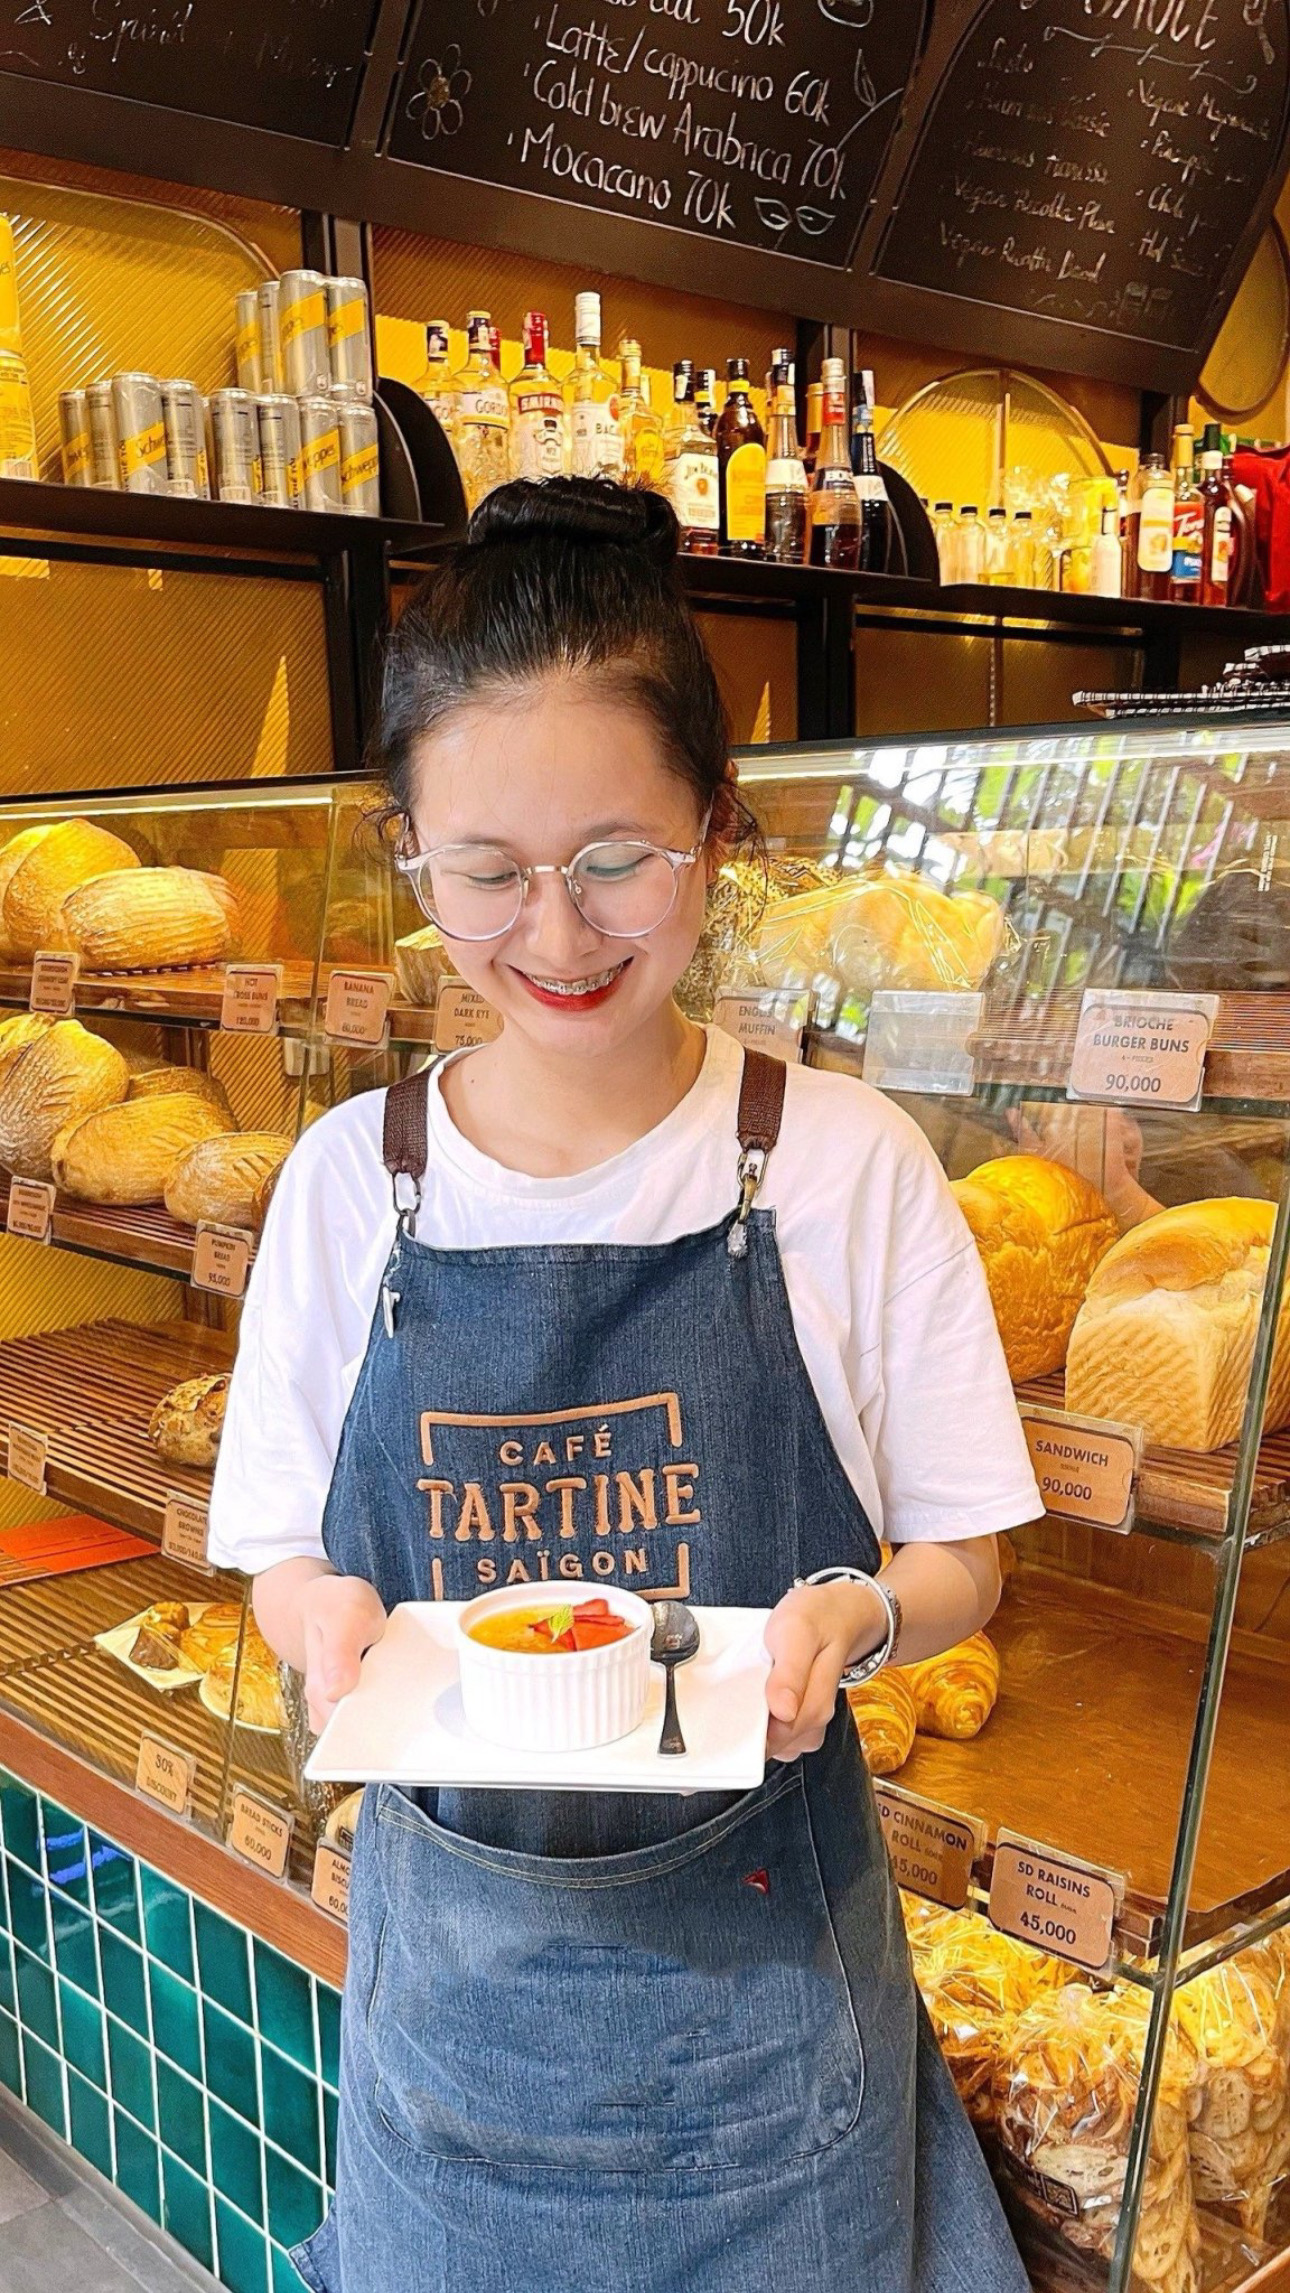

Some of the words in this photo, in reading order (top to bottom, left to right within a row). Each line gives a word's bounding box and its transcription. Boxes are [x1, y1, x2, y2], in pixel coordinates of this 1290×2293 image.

[722, 0, 785, 47] 50k
[785, 70, 830, 126] 60k
[534, 60, 595, 117] Cold
[673, 102, 792, 184] Arabrica
[684, 170, 736, 229] 70k
[344, 981, 375, 995] BANANA
[738, 1022, 776, 1036] MUFFIN
[1113, 1015, 1176, 1031] BRIOCHE
[1093, 1034, 1147, 1050] BURGER
[1149, 1037, 1190, 1053] BUNS
[1105, 1073, 1162, 1093] 90,000
[499, 1423, 613, 1466] CAFÉ
[1036, 1440, 1109, 1467] SANDWICH
[416, 1463, 701, 1542] TARTINE
[1042, 1476, 1092, 1501] 90,000
[476, 1548, 648, 1584] SAÏGON
[240, 1803, 262, 1822] BREAD
[262, 1817, 284, 1837] STICKS
[893, 1810, 967, 1851] CINNAMON
[891, 1829, 921, 1853] ROLL
[1017, 1861, 1034, 1877] SD
[1037, 1868, 1091, 1898] RAISINS
[1026, 1883, 1058, 1907] ROLL
[1020, 1911, 1077, 1945] 45,000
